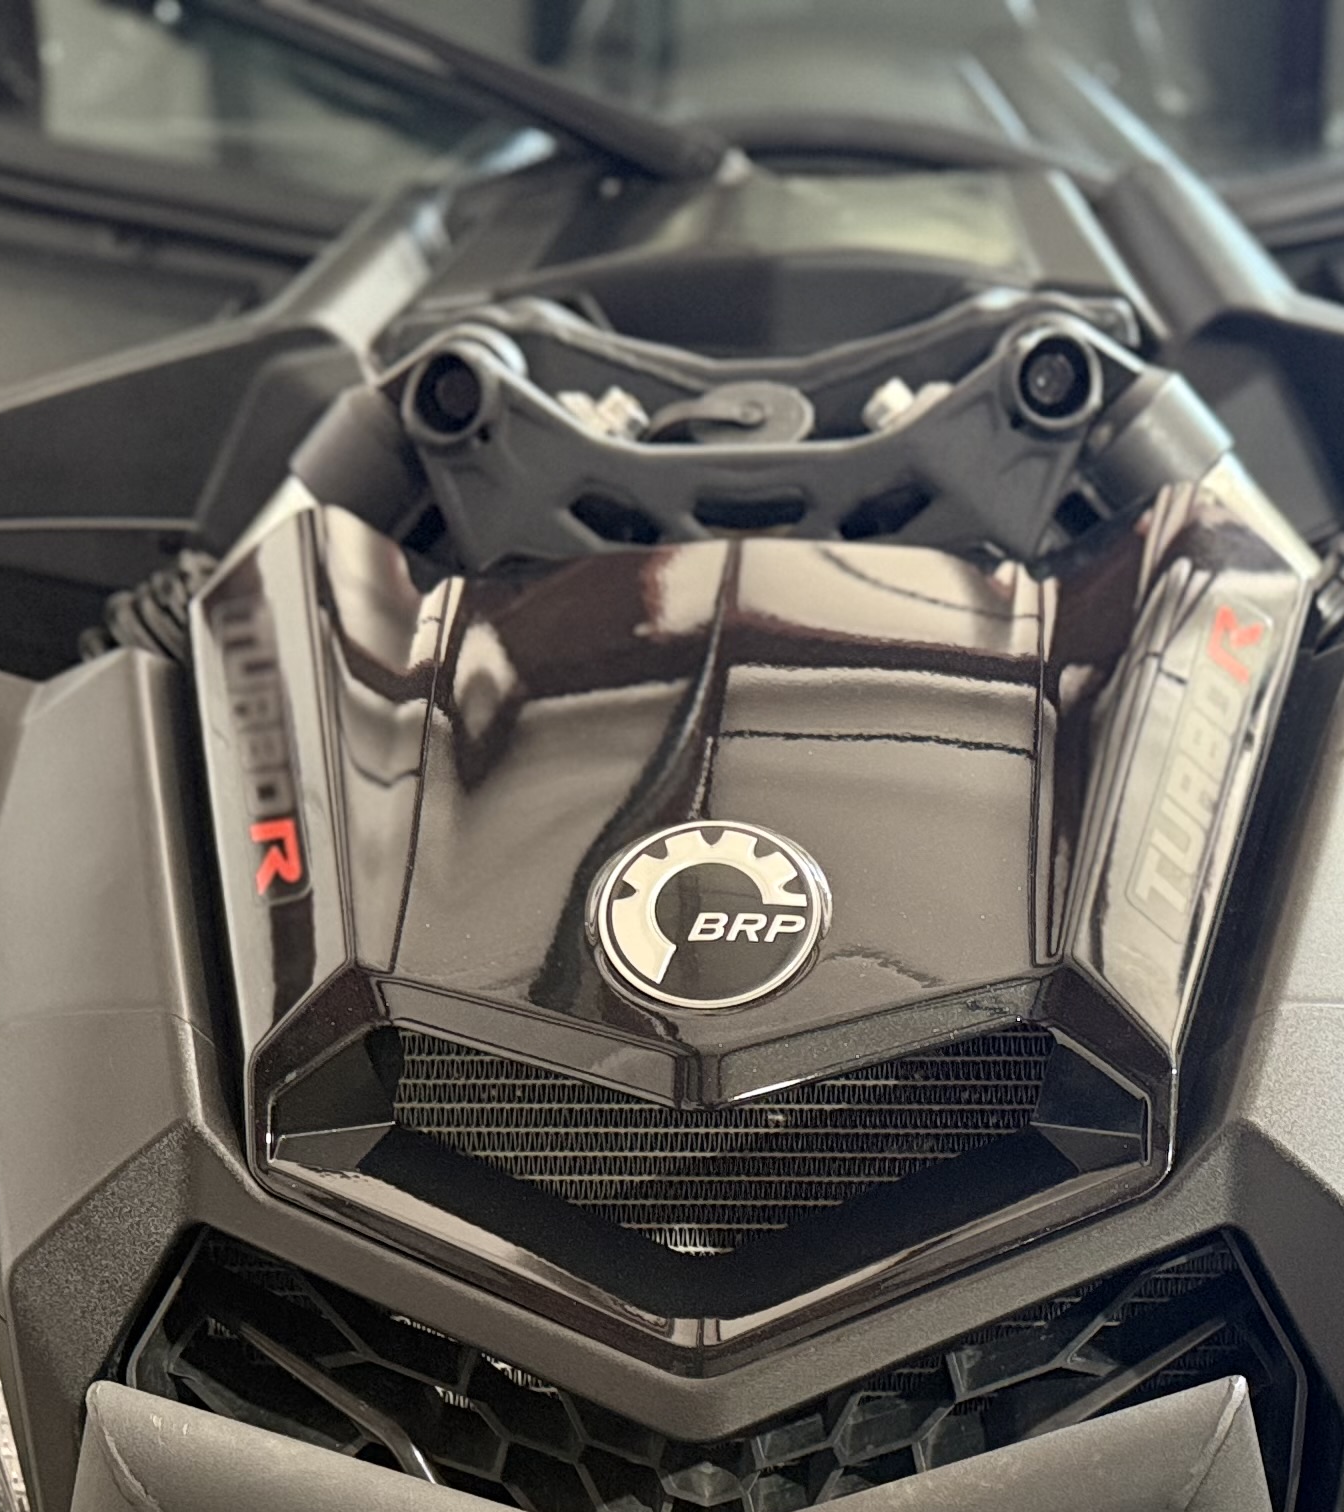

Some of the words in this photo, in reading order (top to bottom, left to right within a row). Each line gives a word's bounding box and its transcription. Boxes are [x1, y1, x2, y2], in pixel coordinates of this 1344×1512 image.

[1134, 681, 1244, 915] TURBO
[1206, 604, 1264, 684] R
[249, 817, 302, 896] R
[687, 912, 806, 943] BRP
